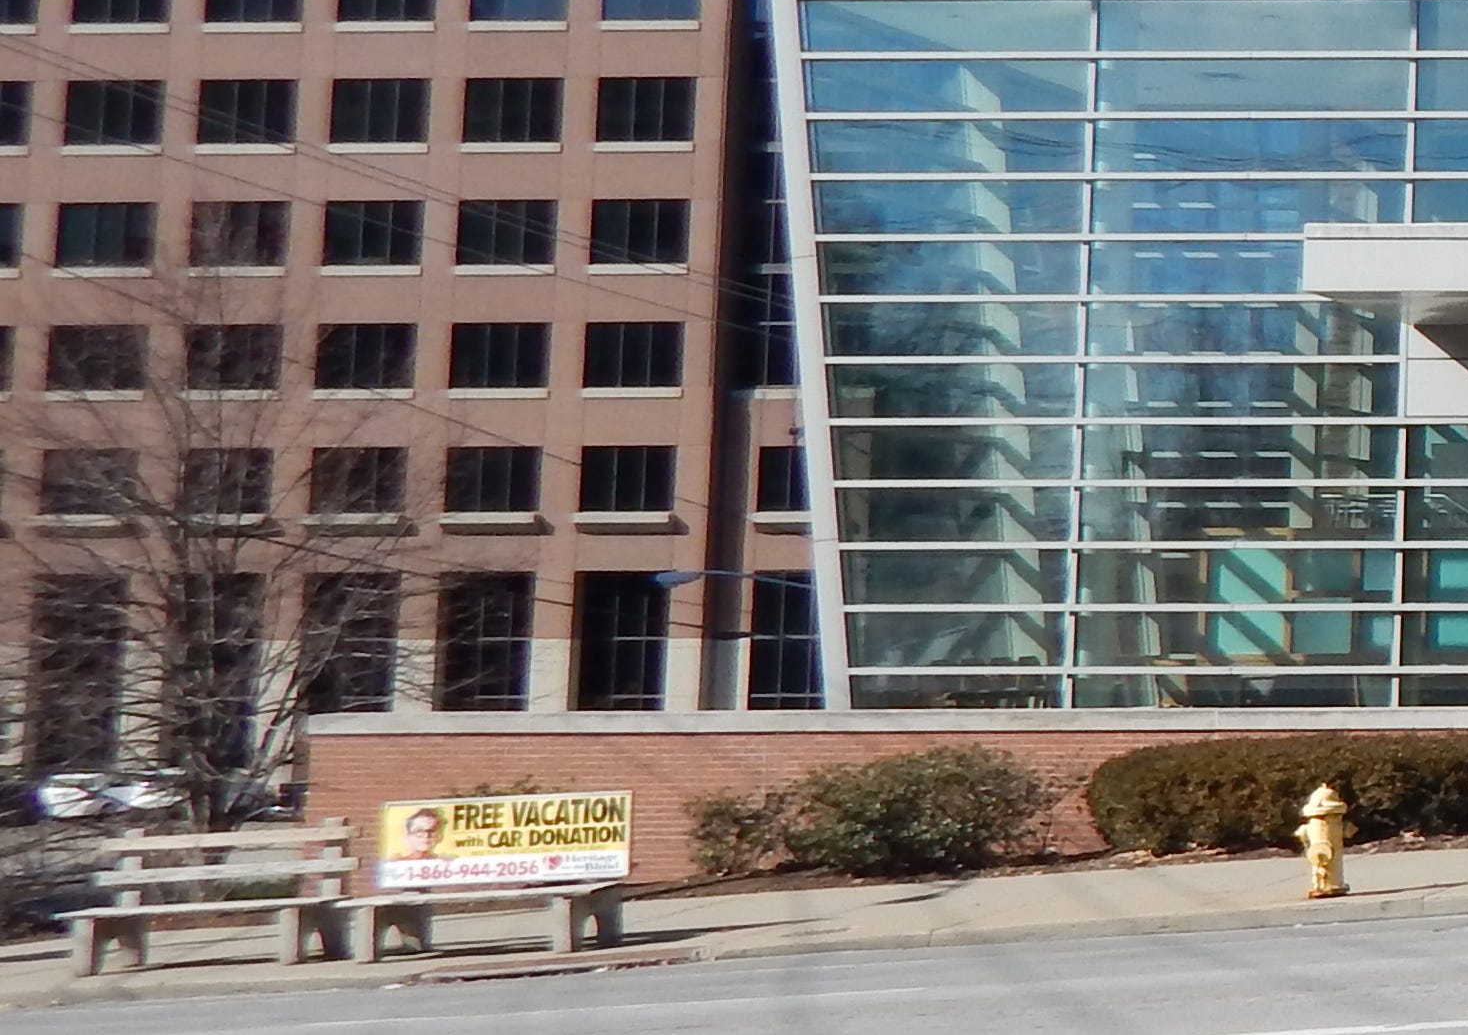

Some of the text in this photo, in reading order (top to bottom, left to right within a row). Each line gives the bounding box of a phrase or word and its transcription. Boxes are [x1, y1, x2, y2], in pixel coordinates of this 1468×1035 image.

[452, 796, 627, 830] FREE VACATION
[455, 824, 626, 848] with CAR DONATION
[406, 860, 540, 881] 1-866-944-2056
